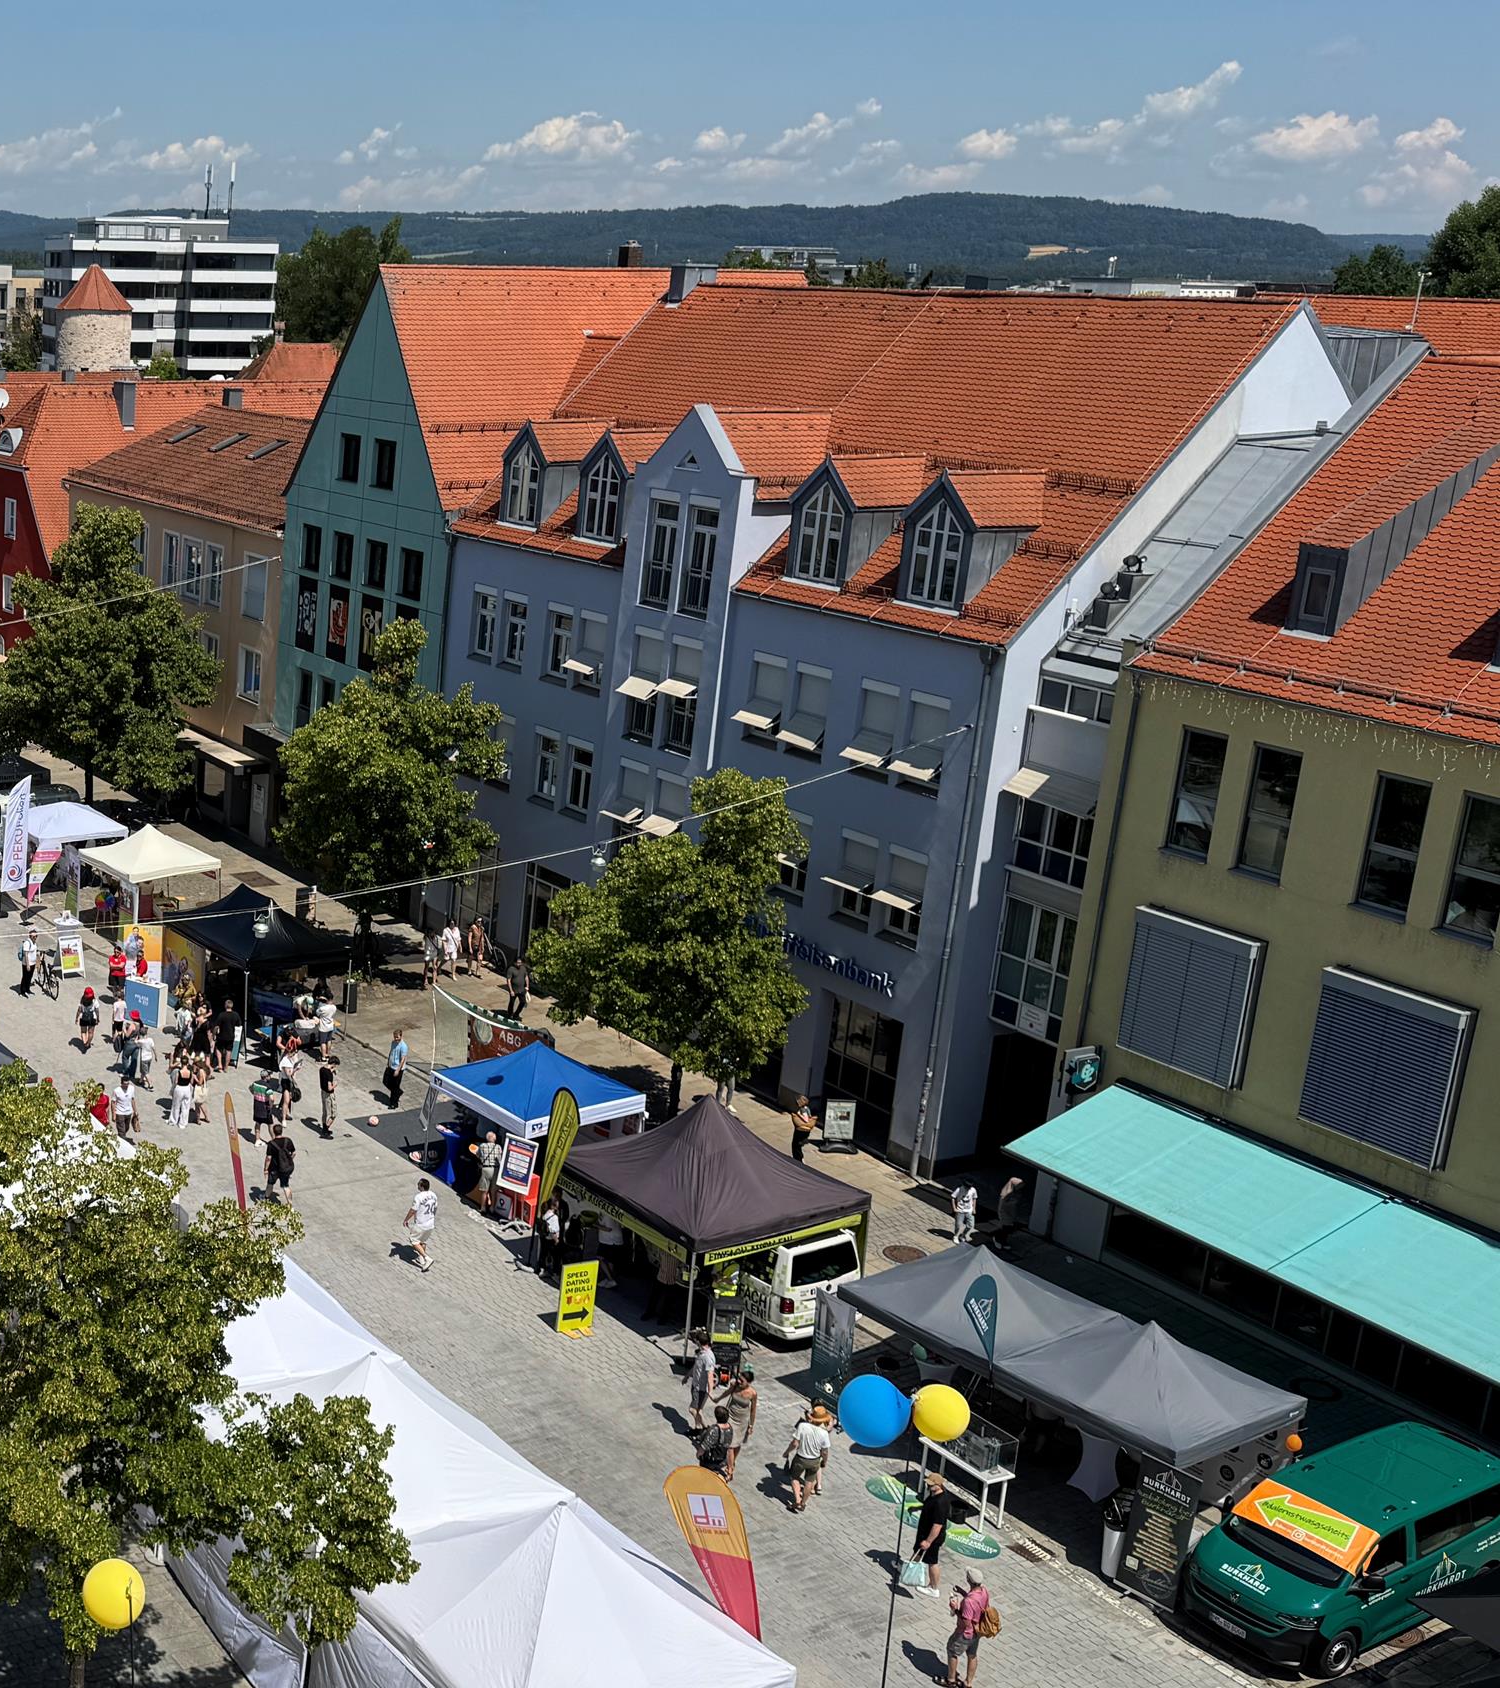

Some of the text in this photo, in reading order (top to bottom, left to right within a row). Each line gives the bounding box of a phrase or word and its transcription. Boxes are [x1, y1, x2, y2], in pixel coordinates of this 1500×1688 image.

[499, 1030, 523, 1047] ABG
[566, 1278, 591, 1287] DATING
[567, 1270, 589, 1280] SPEED
[565, 1285, 593, 1294] IM BULLI
[969, 1297, 989, 1333] BURKHARDT
[1143, 1475, 1192, 1504] BURKHARDT
[1221, 1563, 1272, 1593] BURKHARDT
